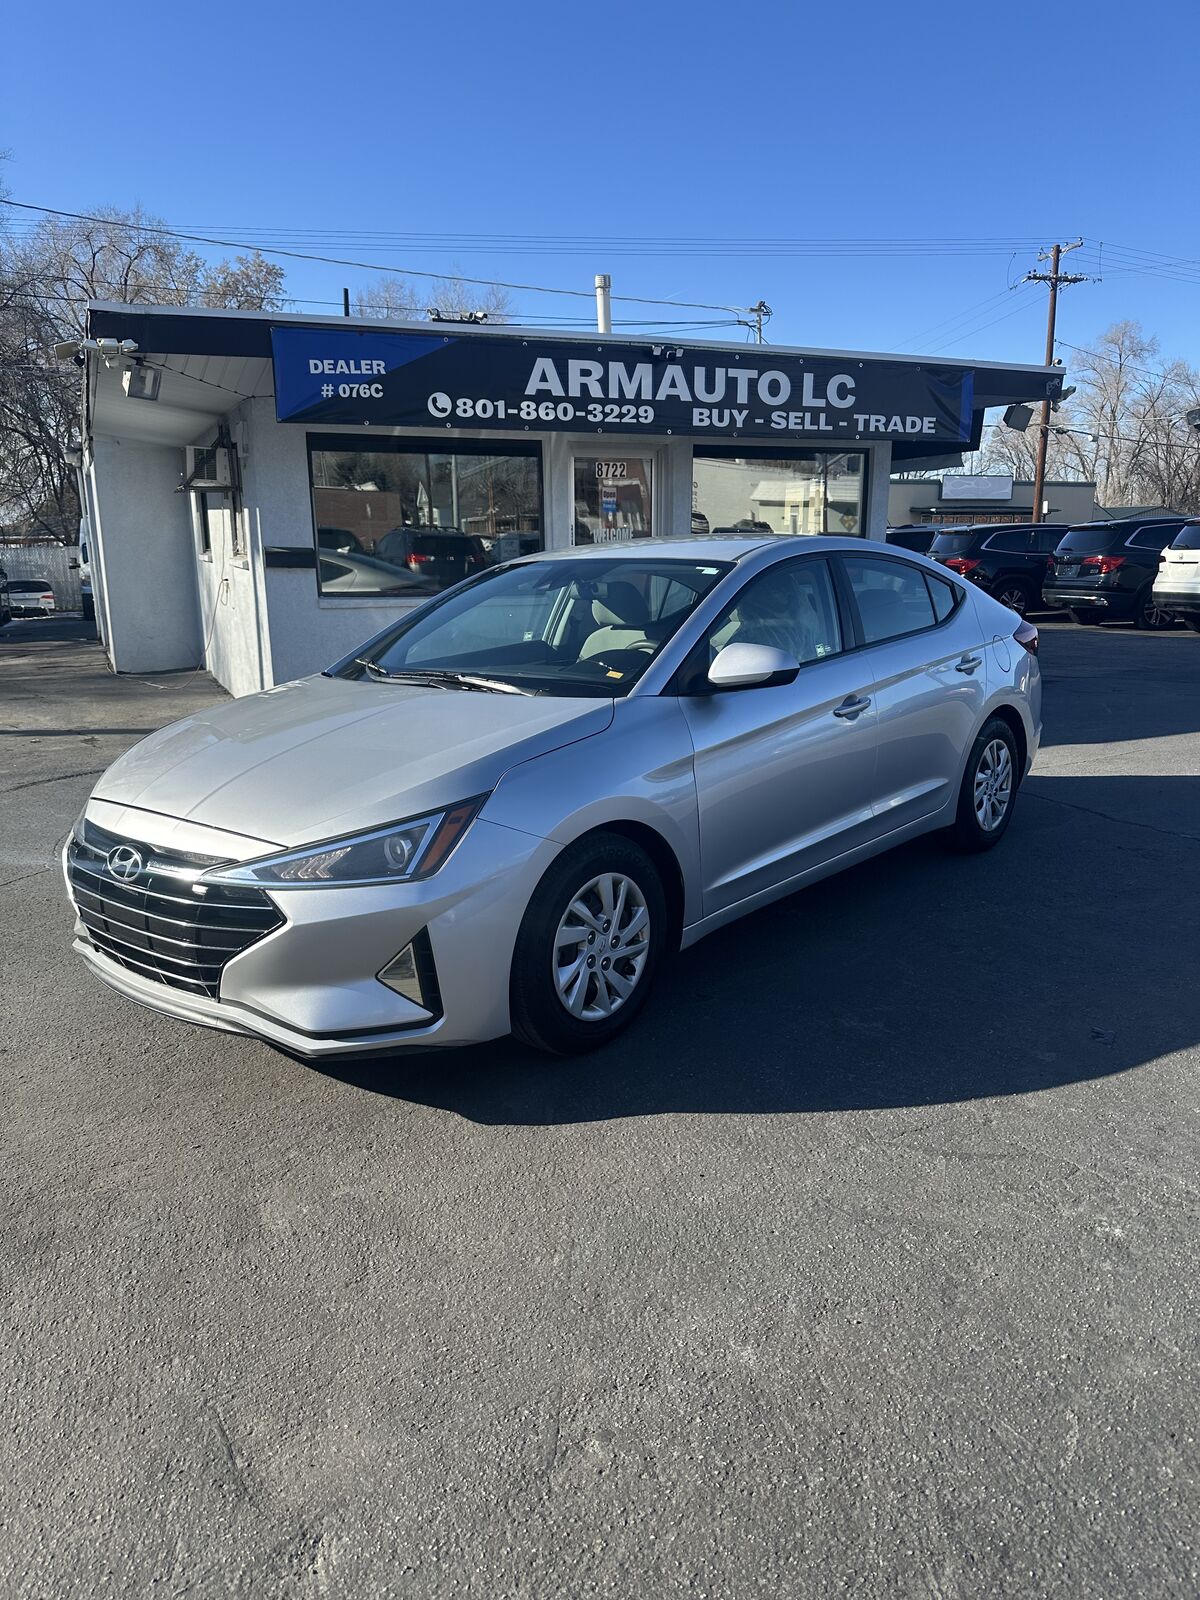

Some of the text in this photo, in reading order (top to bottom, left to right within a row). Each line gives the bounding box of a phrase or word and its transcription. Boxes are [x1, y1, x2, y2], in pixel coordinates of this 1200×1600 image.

[309, 359, 386, 375] DEALER
[523, 356, 856, 409] ARMAUTO LC
[321, 383, 384, 399] # 076C
[455, 398, 655, 425] 801-860-3229
[692, 407, 749, 428] BUY
[770, 411, 833, 431] SELL
[853, 414, 937, 434] TRADE
[596, 462, 627, 478] 8722
[593, 528, 634, 544] WELCOME
